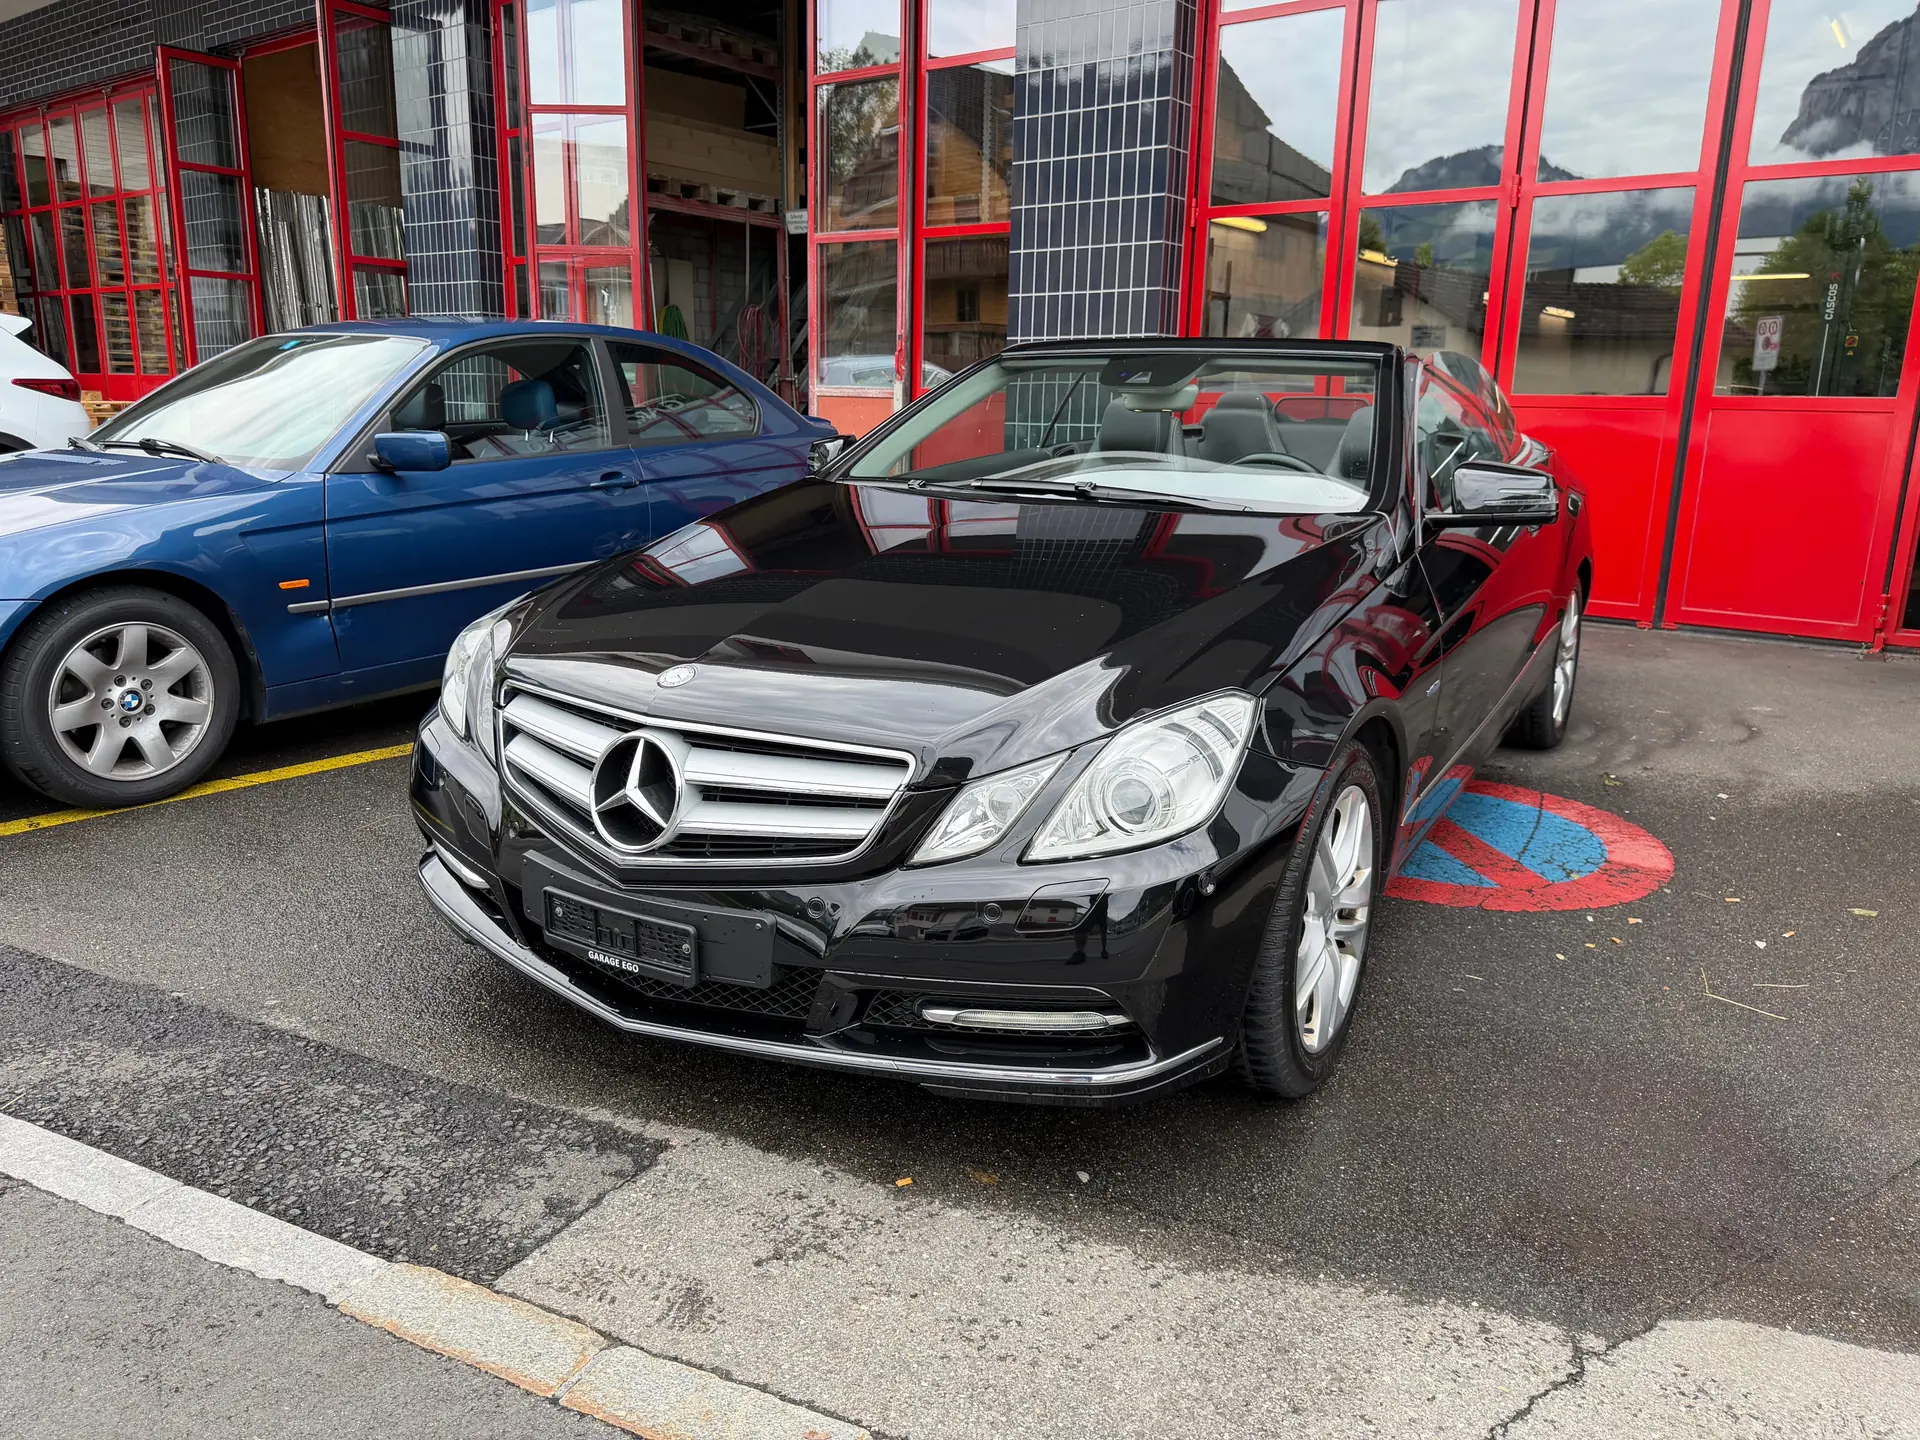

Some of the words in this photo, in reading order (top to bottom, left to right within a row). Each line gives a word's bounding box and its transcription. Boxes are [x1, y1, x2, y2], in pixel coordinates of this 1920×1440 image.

[1824, 283, 1839, 320] CASCOS
[588, 951, 620, 968] GARAGE
[621, 961, 639, 973] EGO
